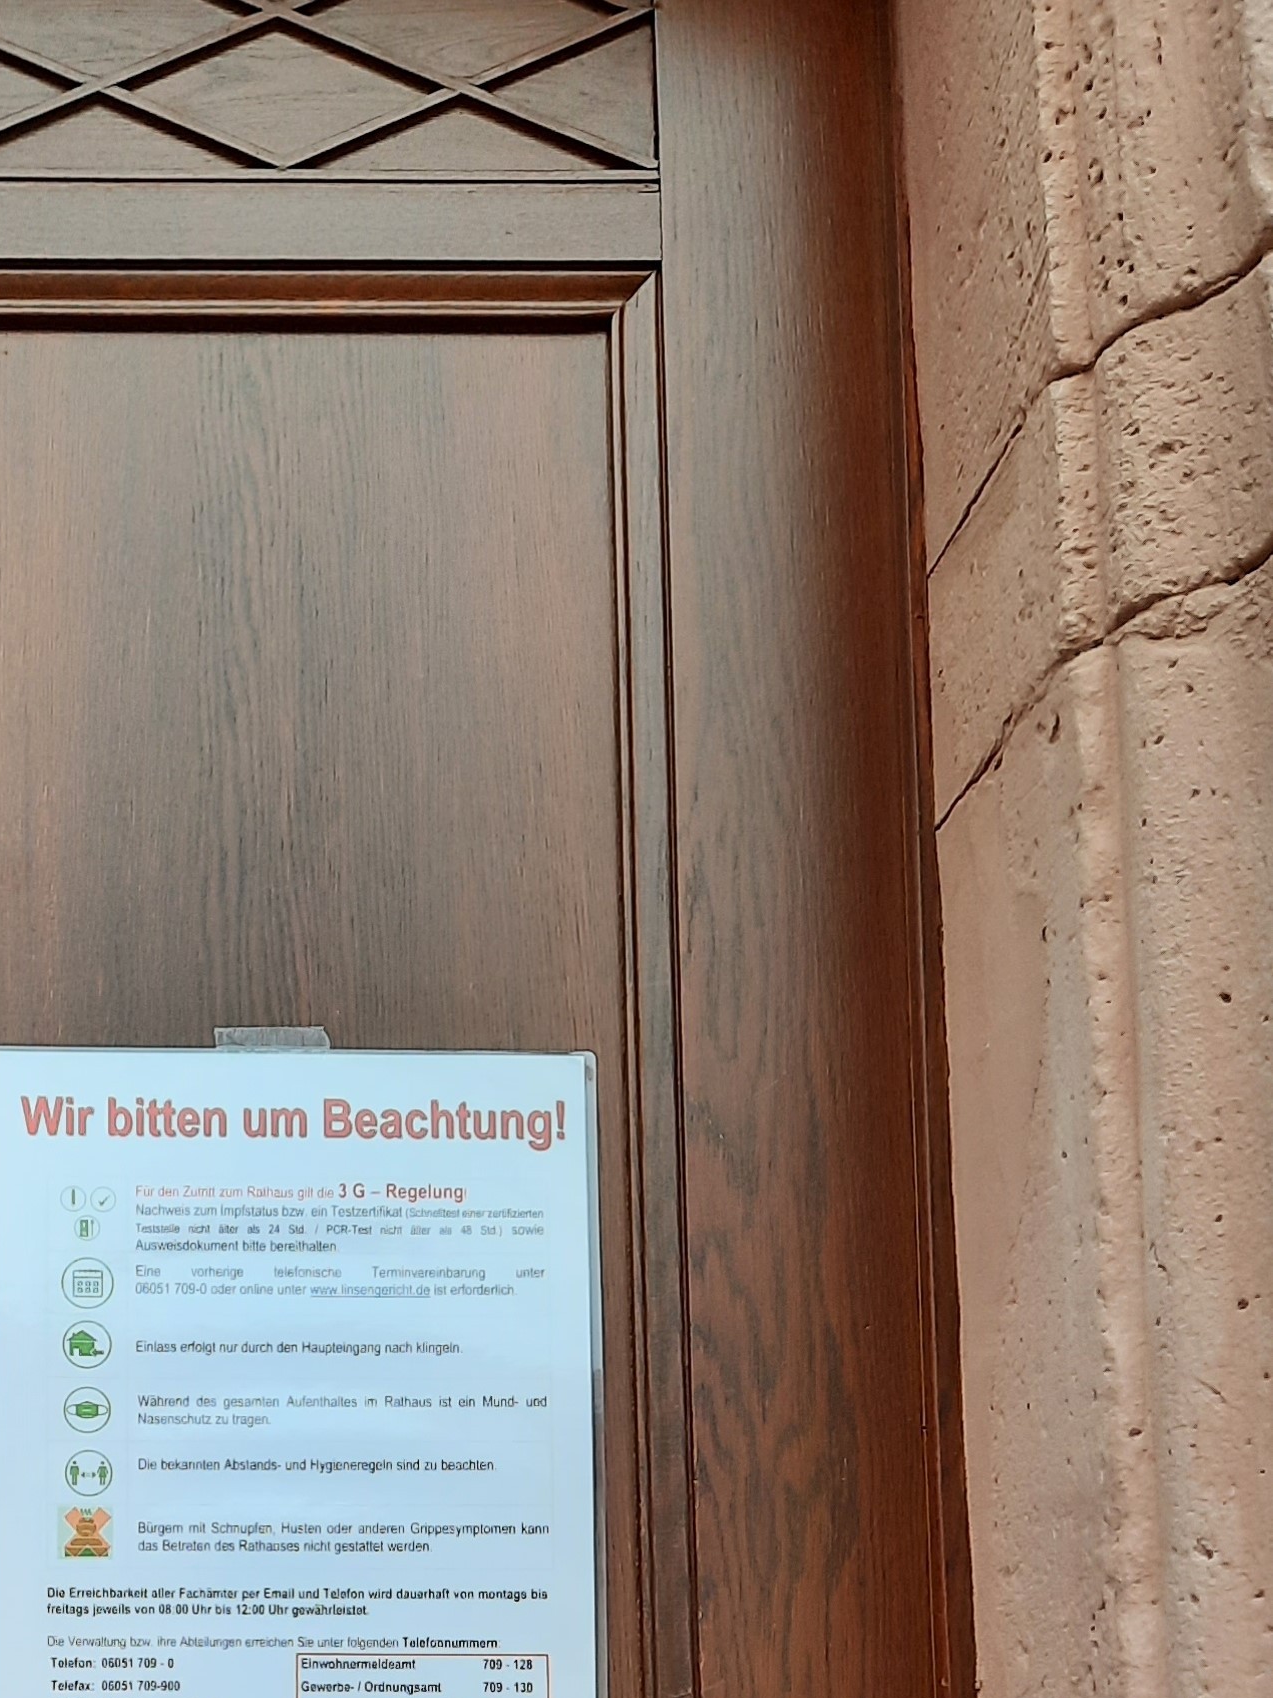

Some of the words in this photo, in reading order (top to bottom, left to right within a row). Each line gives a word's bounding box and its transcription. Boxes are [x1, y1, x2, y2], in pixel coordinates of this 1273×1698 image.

[21, 1096, 95, 1136] Wir
[108, 1097, 227, 1138] bitten
[243, 1108, 308, 1138] um
[323, 1098, 565, 1151] Beachtung!
[136, 1239, 239, 1251] Ausweisdokument
[242, 1240, 267, 1252] bitte
[136, 1340, 177, 1353] Einlass
[180, 1341, 216, 1356] erfolgt
[219, 1343, 238, 1353] nur
[241, 1341, 273, 1353] durch
[276, 1341, 298, 1354] den
[302, 1341, 381, 1357] Haupteingang
[385, 1341, 413, 1353] nach
[137, 1395, 190, 1407] Während
[196, 1396, 217, 1407] des
[223, 1397, 279, 1410] gesamten
[287, 1395, 357, 1408] Aufenthaltes
[364, 1398, 378, 1407] im
[384, 1395, 432, 1408] Rathaus
[439, 1396, 452, 1408] ist
[458, 1395, 476, 1408] ein
[482, 1395, 519, 1408] Mund-
[526, 1395, 547, 1408] und
[138, 1412, 212, 1425] Nasenschutz
[215, 1415, 229, 1425] zu
[138, 1458, 157, 1470] Die
[160, 1459, 220, 1470] bekannten
[224, 1458, 281, 1471] Abstands-
[285, 1459, 306, 1471] und
[310, 1459, 393, 1474] Hygieneregeln
[396, 1459, 420, 1471] sind
[424, 1461, 437, 1471] zu
[138, 1521, 183, 1537] Bürgern
[189, 1523, 206, 1533] mit
[211, 1522, 275, 1536] Schnupfen,
[281, 1522, 322, 1534] Husten
[326, 1523, 352, 1534] oder
[358, 1522, 405, 1534] anderen
[410, 1522, 516, 1538] Grippesymptomen
[521, 1522, 549, 1535] kann
[138, 1540, 158, 1551] das
[162, 1539, 211, 1551] Betreten
[214, 1540, 235, 1552] des
[238, 1539, 300, 1552] Rathauses
[303, 1540, 331, 1552] nicht
[334, 1540, 384, 1555] gestattet
[47, 1587, 65, 1598] Die
[69, 1587, 148, 1598] Erreichbarkeit
[151, 1587, 175, 1598] aller
[179, 1587, 237, 1599] Fachämter
[241, 1590, 260, 1601] per
[263, 1587, 295, 1599] Email
[298, 1588, 320, 1599] und
[323, 1588, 365, 1599] Telefon
[368, 1588, 392, 1599] wird
[396, 1588, 450, 1599] dauerhaft
[454, 1591, 474, 1599] von
[478, 1590, 527, 1602] montags
[531, 1589, 548, 1599] bis
[47, 1603, 89, 1617] freitags
[92, 1603, 131, 1617] jeweils
[134, 1606, 155, 1614] von
[158, 1603, 189, 1615] 08:00
[192, 1604, 212, 1615] Uhr
[215, 1605, 231, 1615] bis
[236, 1604, 265, 1615] 12:00
[268, 1604, 288, 1615] Uhr
[101, 1657, 133, 1669] 06051
[138, 1657, 157, 1668] 709
[167, 1658, 174, 1669] 0
[301, 1658, 416, 1670] Einwohnermeldeamt
[483, 1659, 503, 1670] 709
[513, 1659, 533, 1670] 128
[101, 1680, 133, 1691] 06051
[138, 1680, 180, 1691] 709-900
[301, 1680, 354, 1692] Gewerbe-
[364, 1681, 441, 1696] Ordnungsamt
[483, 1681, 503, 1693] 709
[514, 1682, 533, 1693] 130
